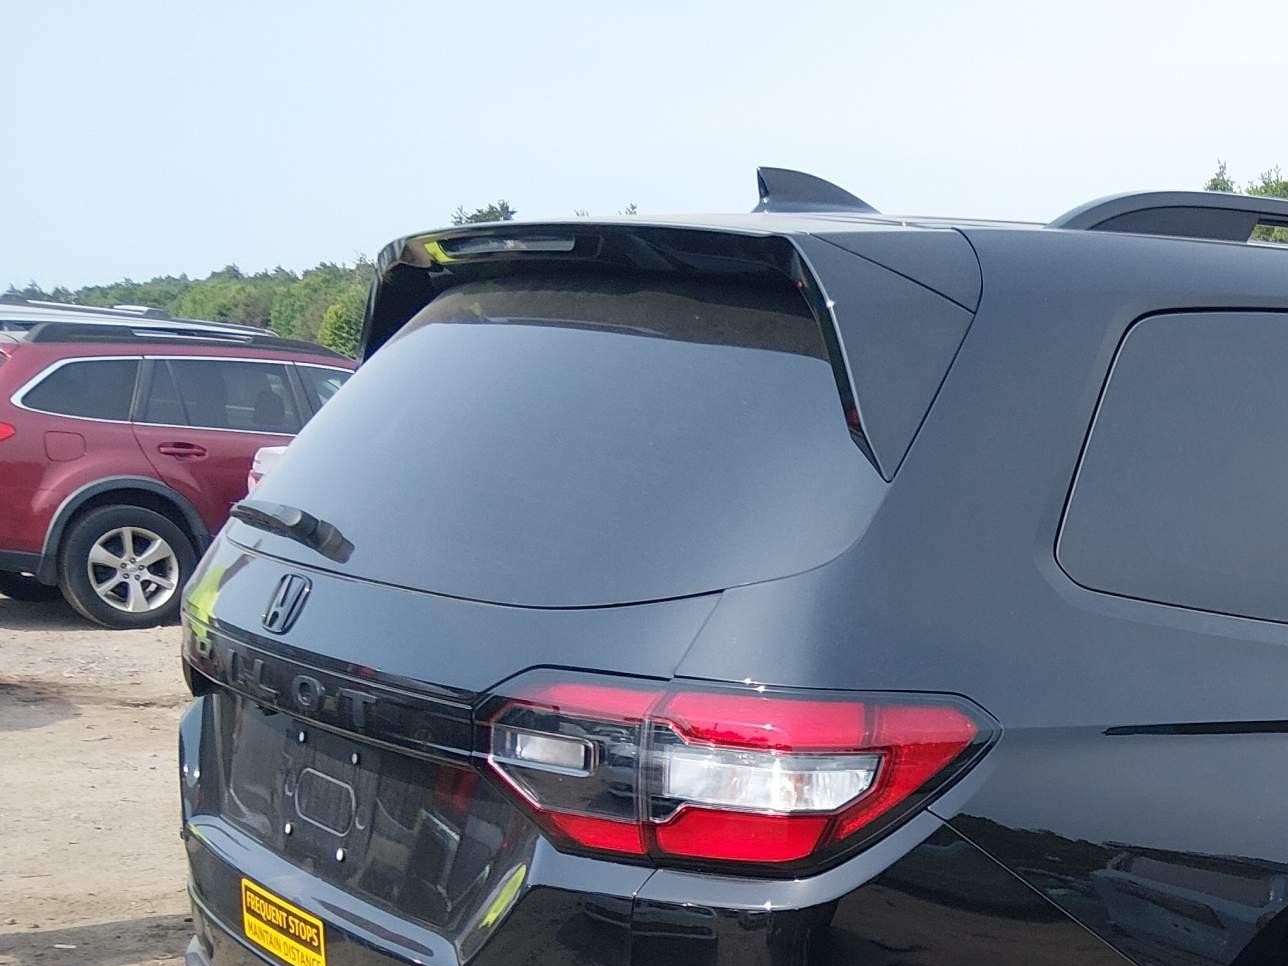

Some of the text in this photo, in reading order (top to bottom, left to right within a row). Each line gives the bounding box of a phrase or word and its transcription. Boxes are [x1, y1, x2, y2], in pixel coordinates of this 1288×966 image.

[193, 632, 378, 728] PILOT
[246, 890, 319, 946] FREQUENT STOPS
[247, 919, 282, 952] MAINTAIN
